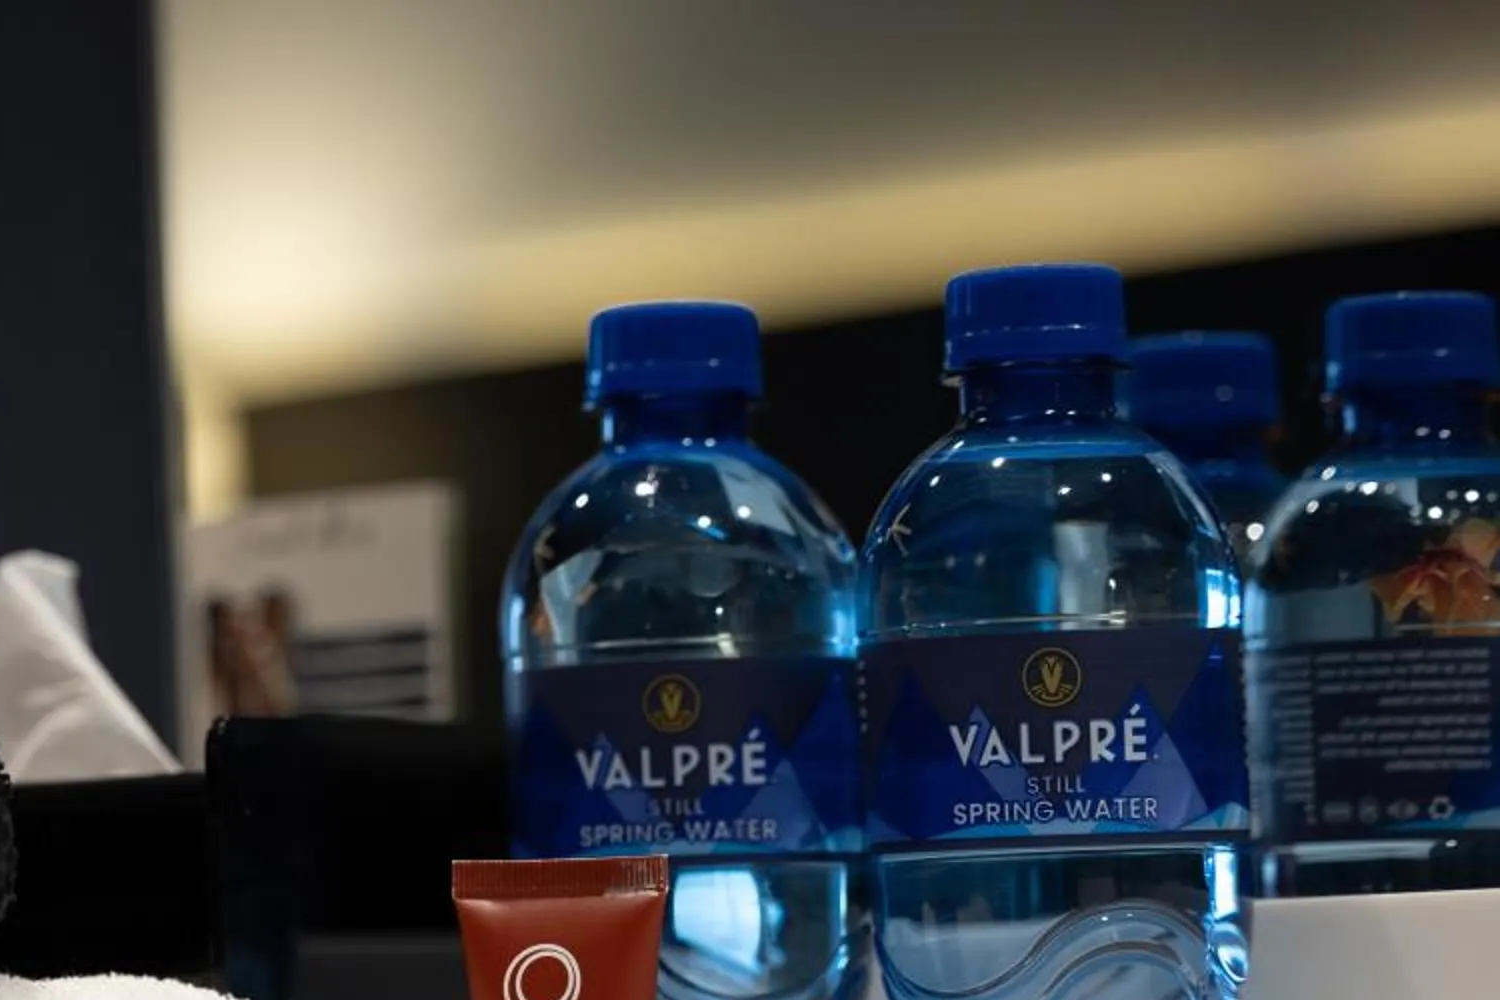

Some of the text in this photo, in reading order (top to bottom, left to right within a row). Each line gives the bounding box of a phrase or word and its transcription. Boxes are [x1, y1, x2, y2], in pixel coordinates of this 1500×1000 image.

[950, 704, 1145, 766] VALPRÉ
[576, 728, 767, 790] VALPRÉ
[1028, 775, 1086, 794] STILL
[650, 798, 705, 817] STILL
[953, 798, 1158, 825] SPRING WATER
[580, 818, 778, 847] SPRING WATER
